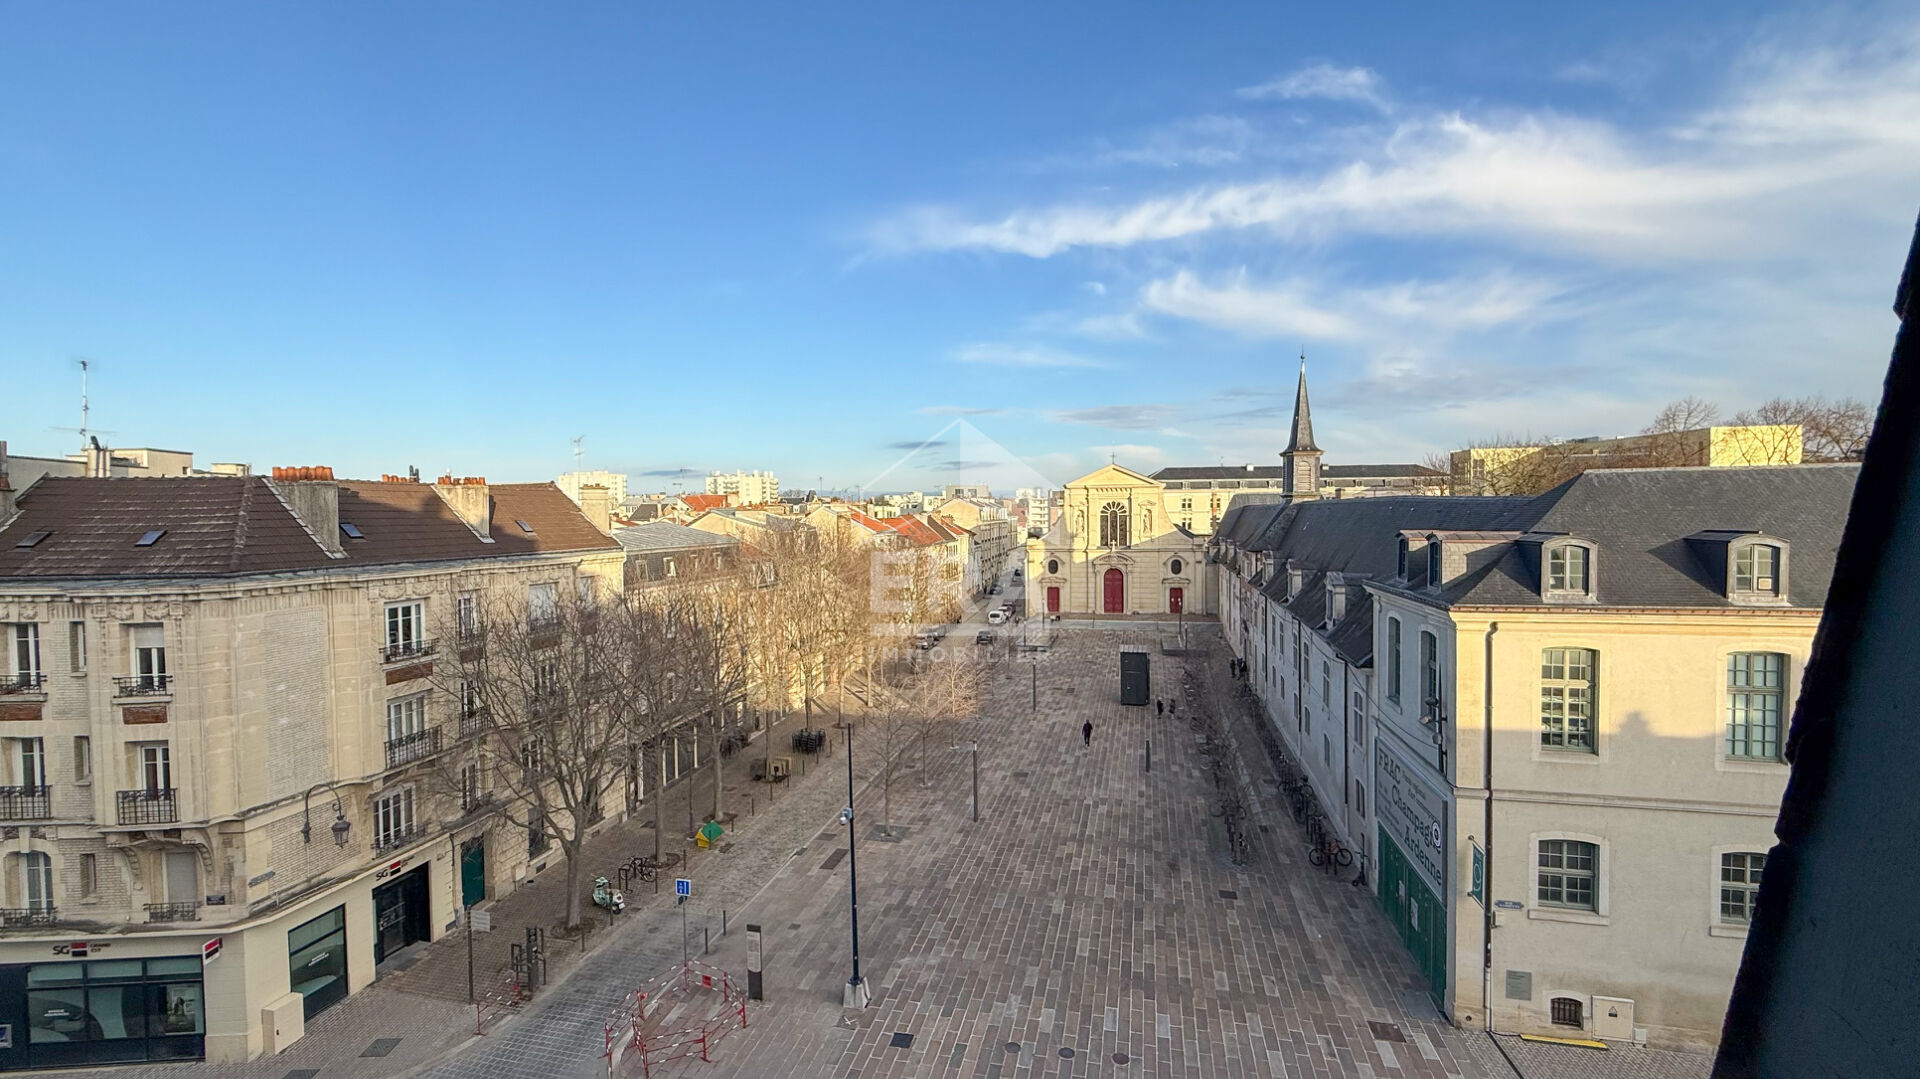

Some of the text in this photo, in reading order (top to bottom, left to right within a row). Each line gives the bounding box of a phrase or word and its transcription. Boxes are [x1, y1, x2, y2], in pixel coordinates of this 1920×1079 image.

[1378, 747, 1401, 785] FRAC
[1403, 825, 1442, 887] Ardenne
[376, 868, 388, 882] SG
[52, 945, 70, 956] SG
